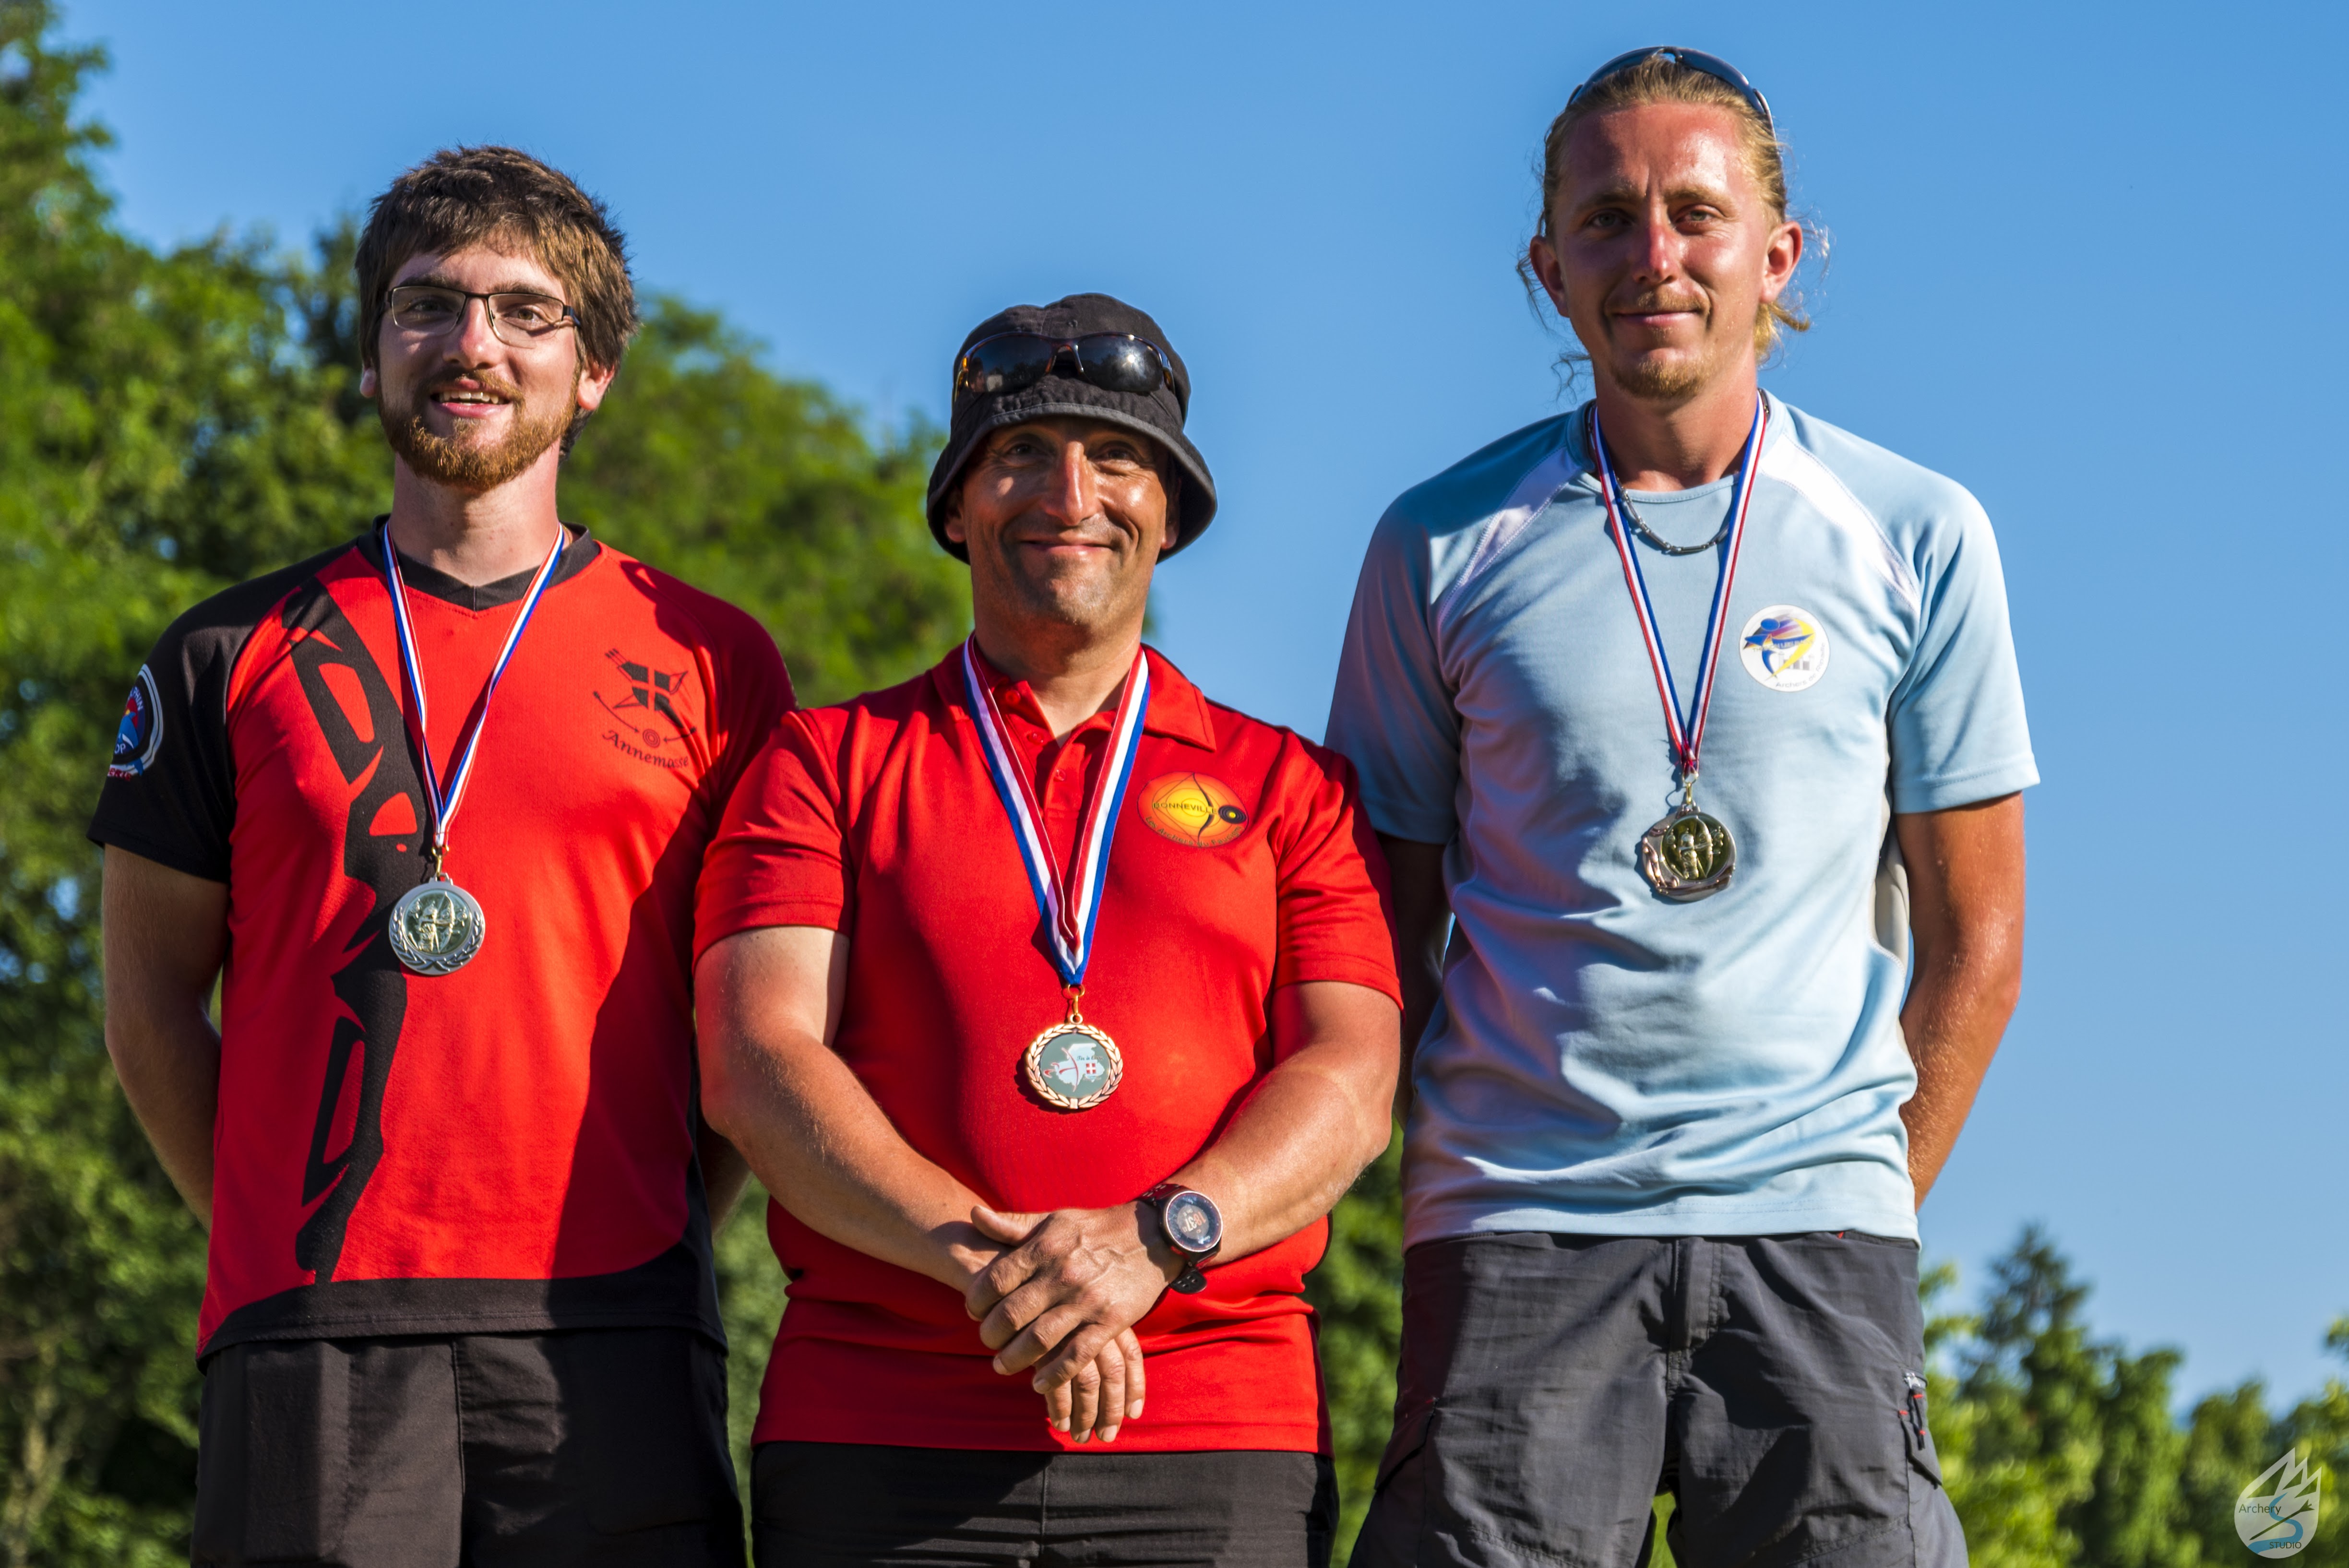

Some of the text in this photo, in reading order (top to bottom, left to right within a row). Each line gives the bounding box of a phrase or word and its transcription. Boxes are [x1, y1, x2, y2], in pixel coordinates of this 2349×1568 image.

[602, 730, 689, 768] Annemasse
[1153, 803, 1217, 814] BONNEVILLE
[1145, 817, 1157, 829] Les
[1157, 828, 1193, 846] Archers
